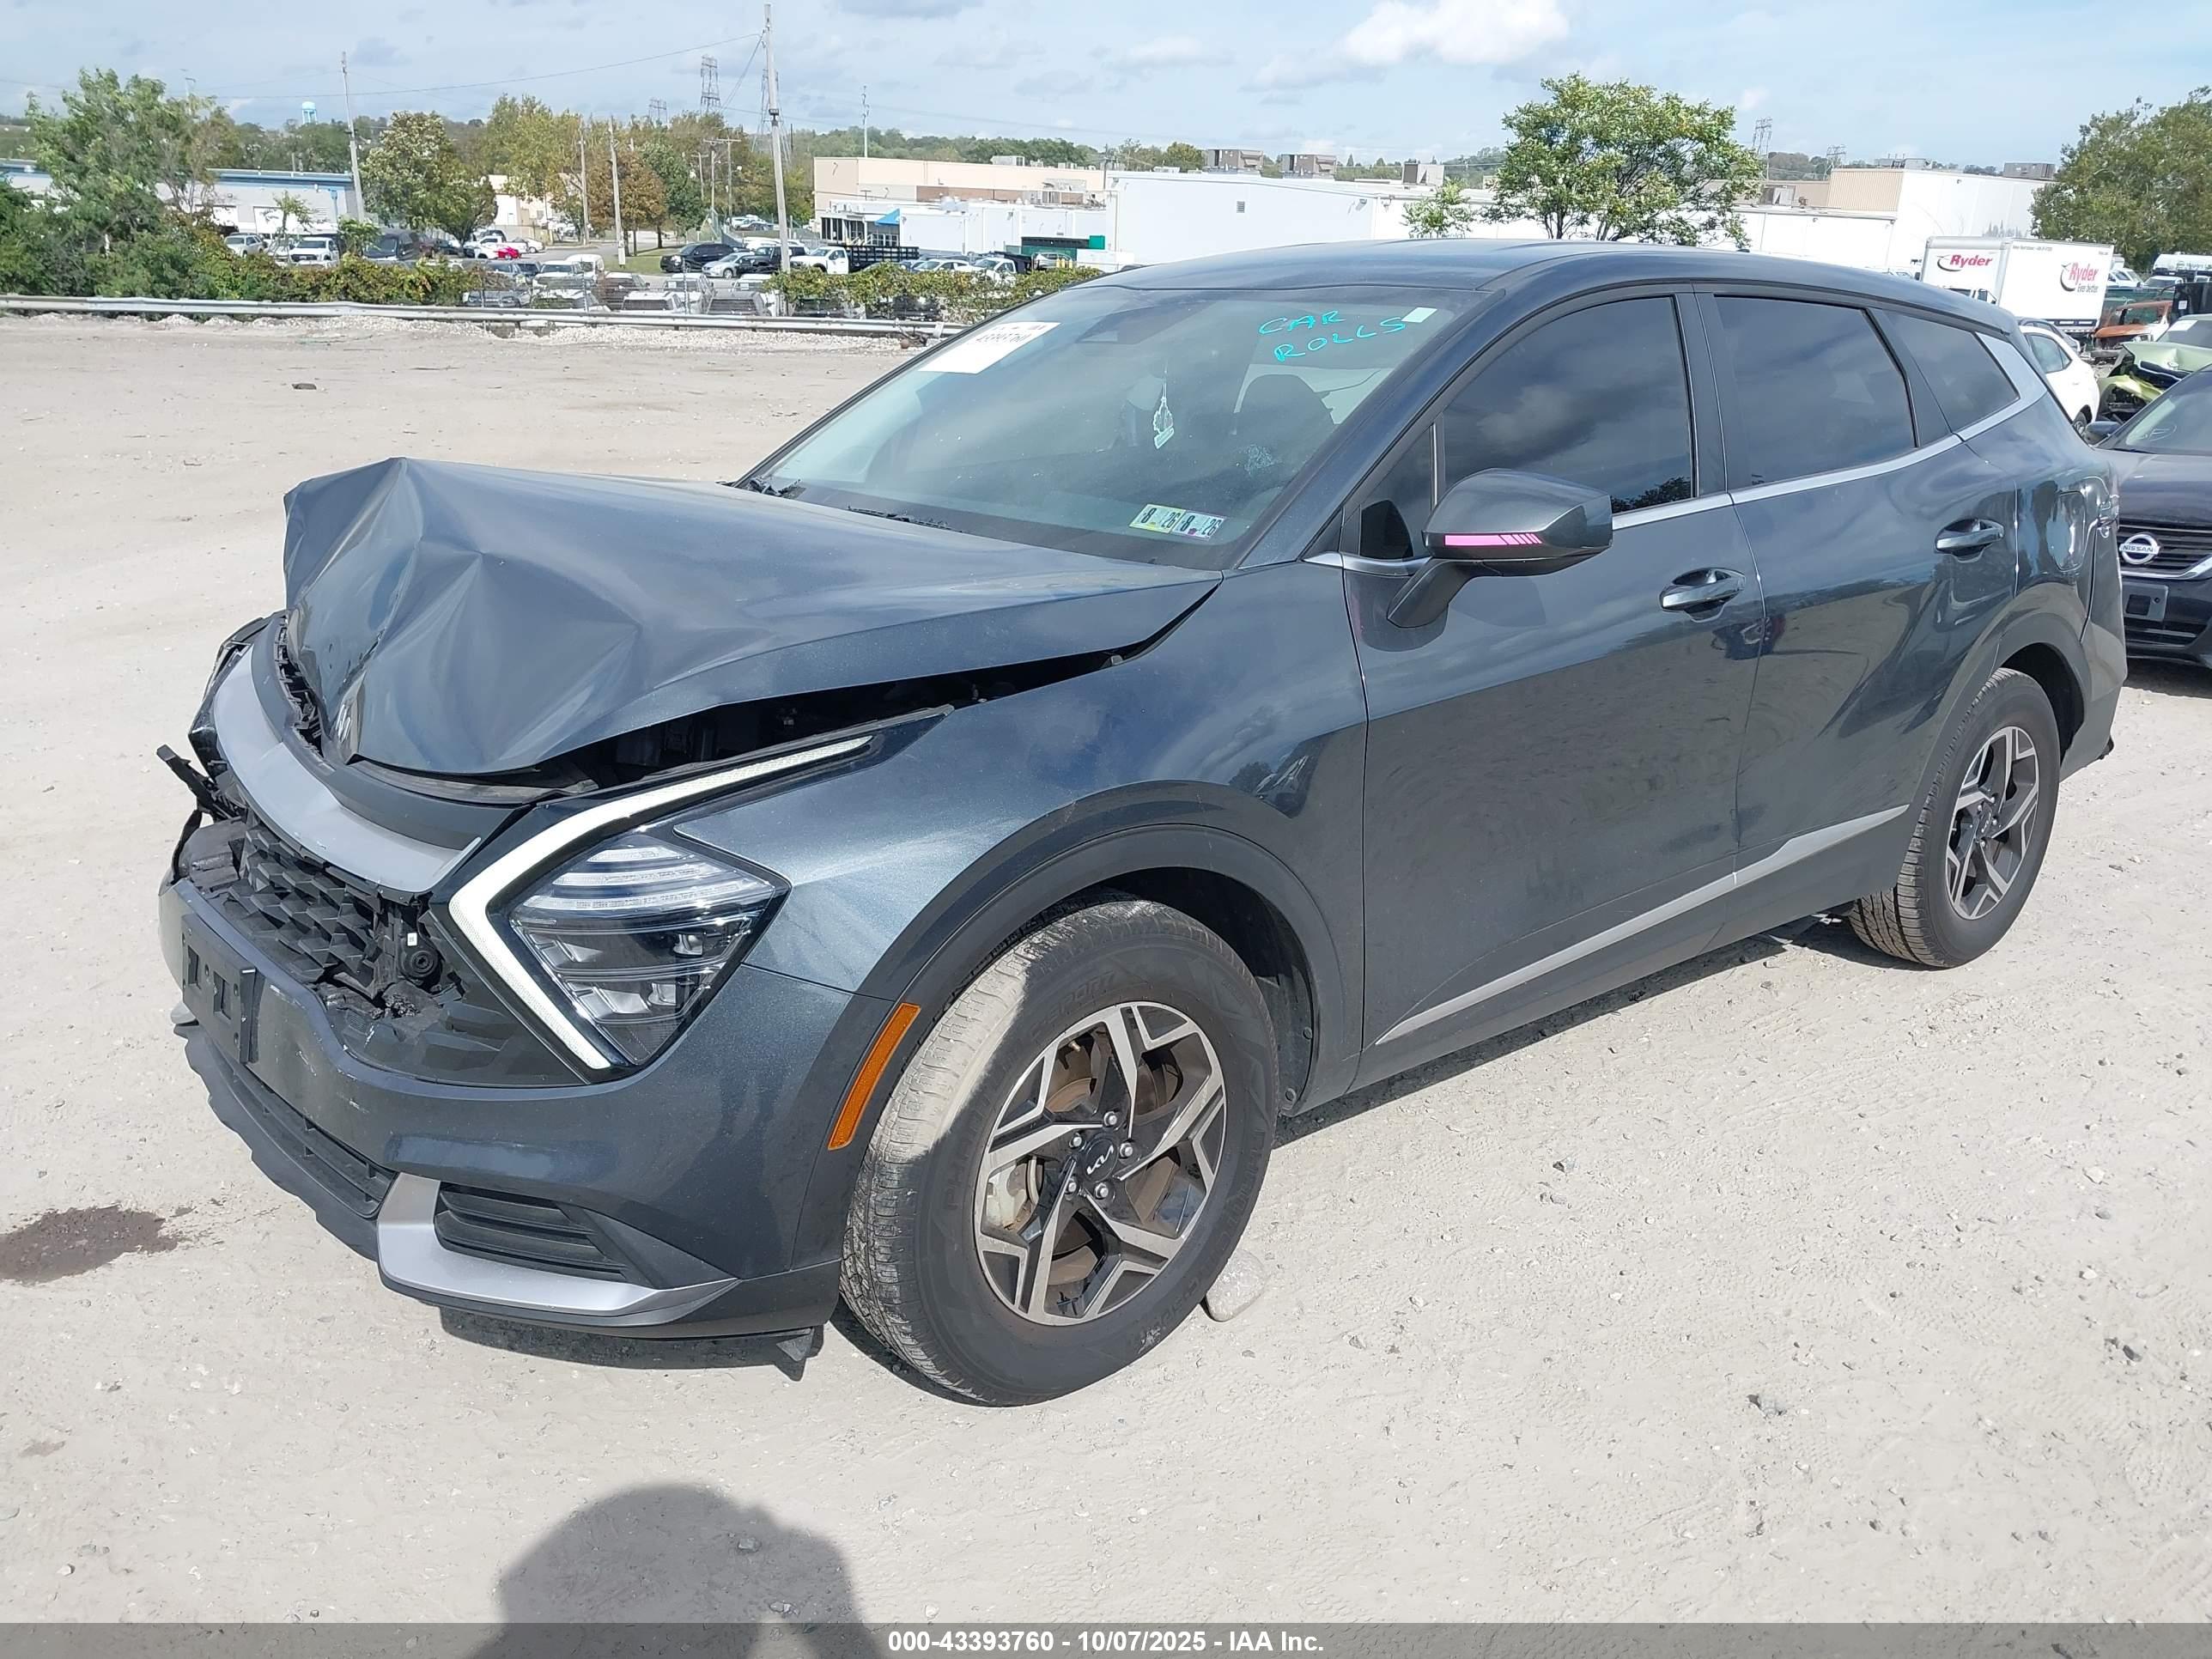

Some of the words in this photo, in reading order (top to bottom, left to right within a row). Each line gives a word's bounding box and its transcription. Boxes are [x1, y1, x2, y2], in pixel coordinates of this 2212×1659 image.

[1949, 254, 1993, 269] Ryder
[2068, 262, 2100, 285] Ryder
[1258, 310, 1346, 335] CAR
[1273, 317, 1407, 362] ROLLS
[2122, 544, 2154, 553] NISSAN
